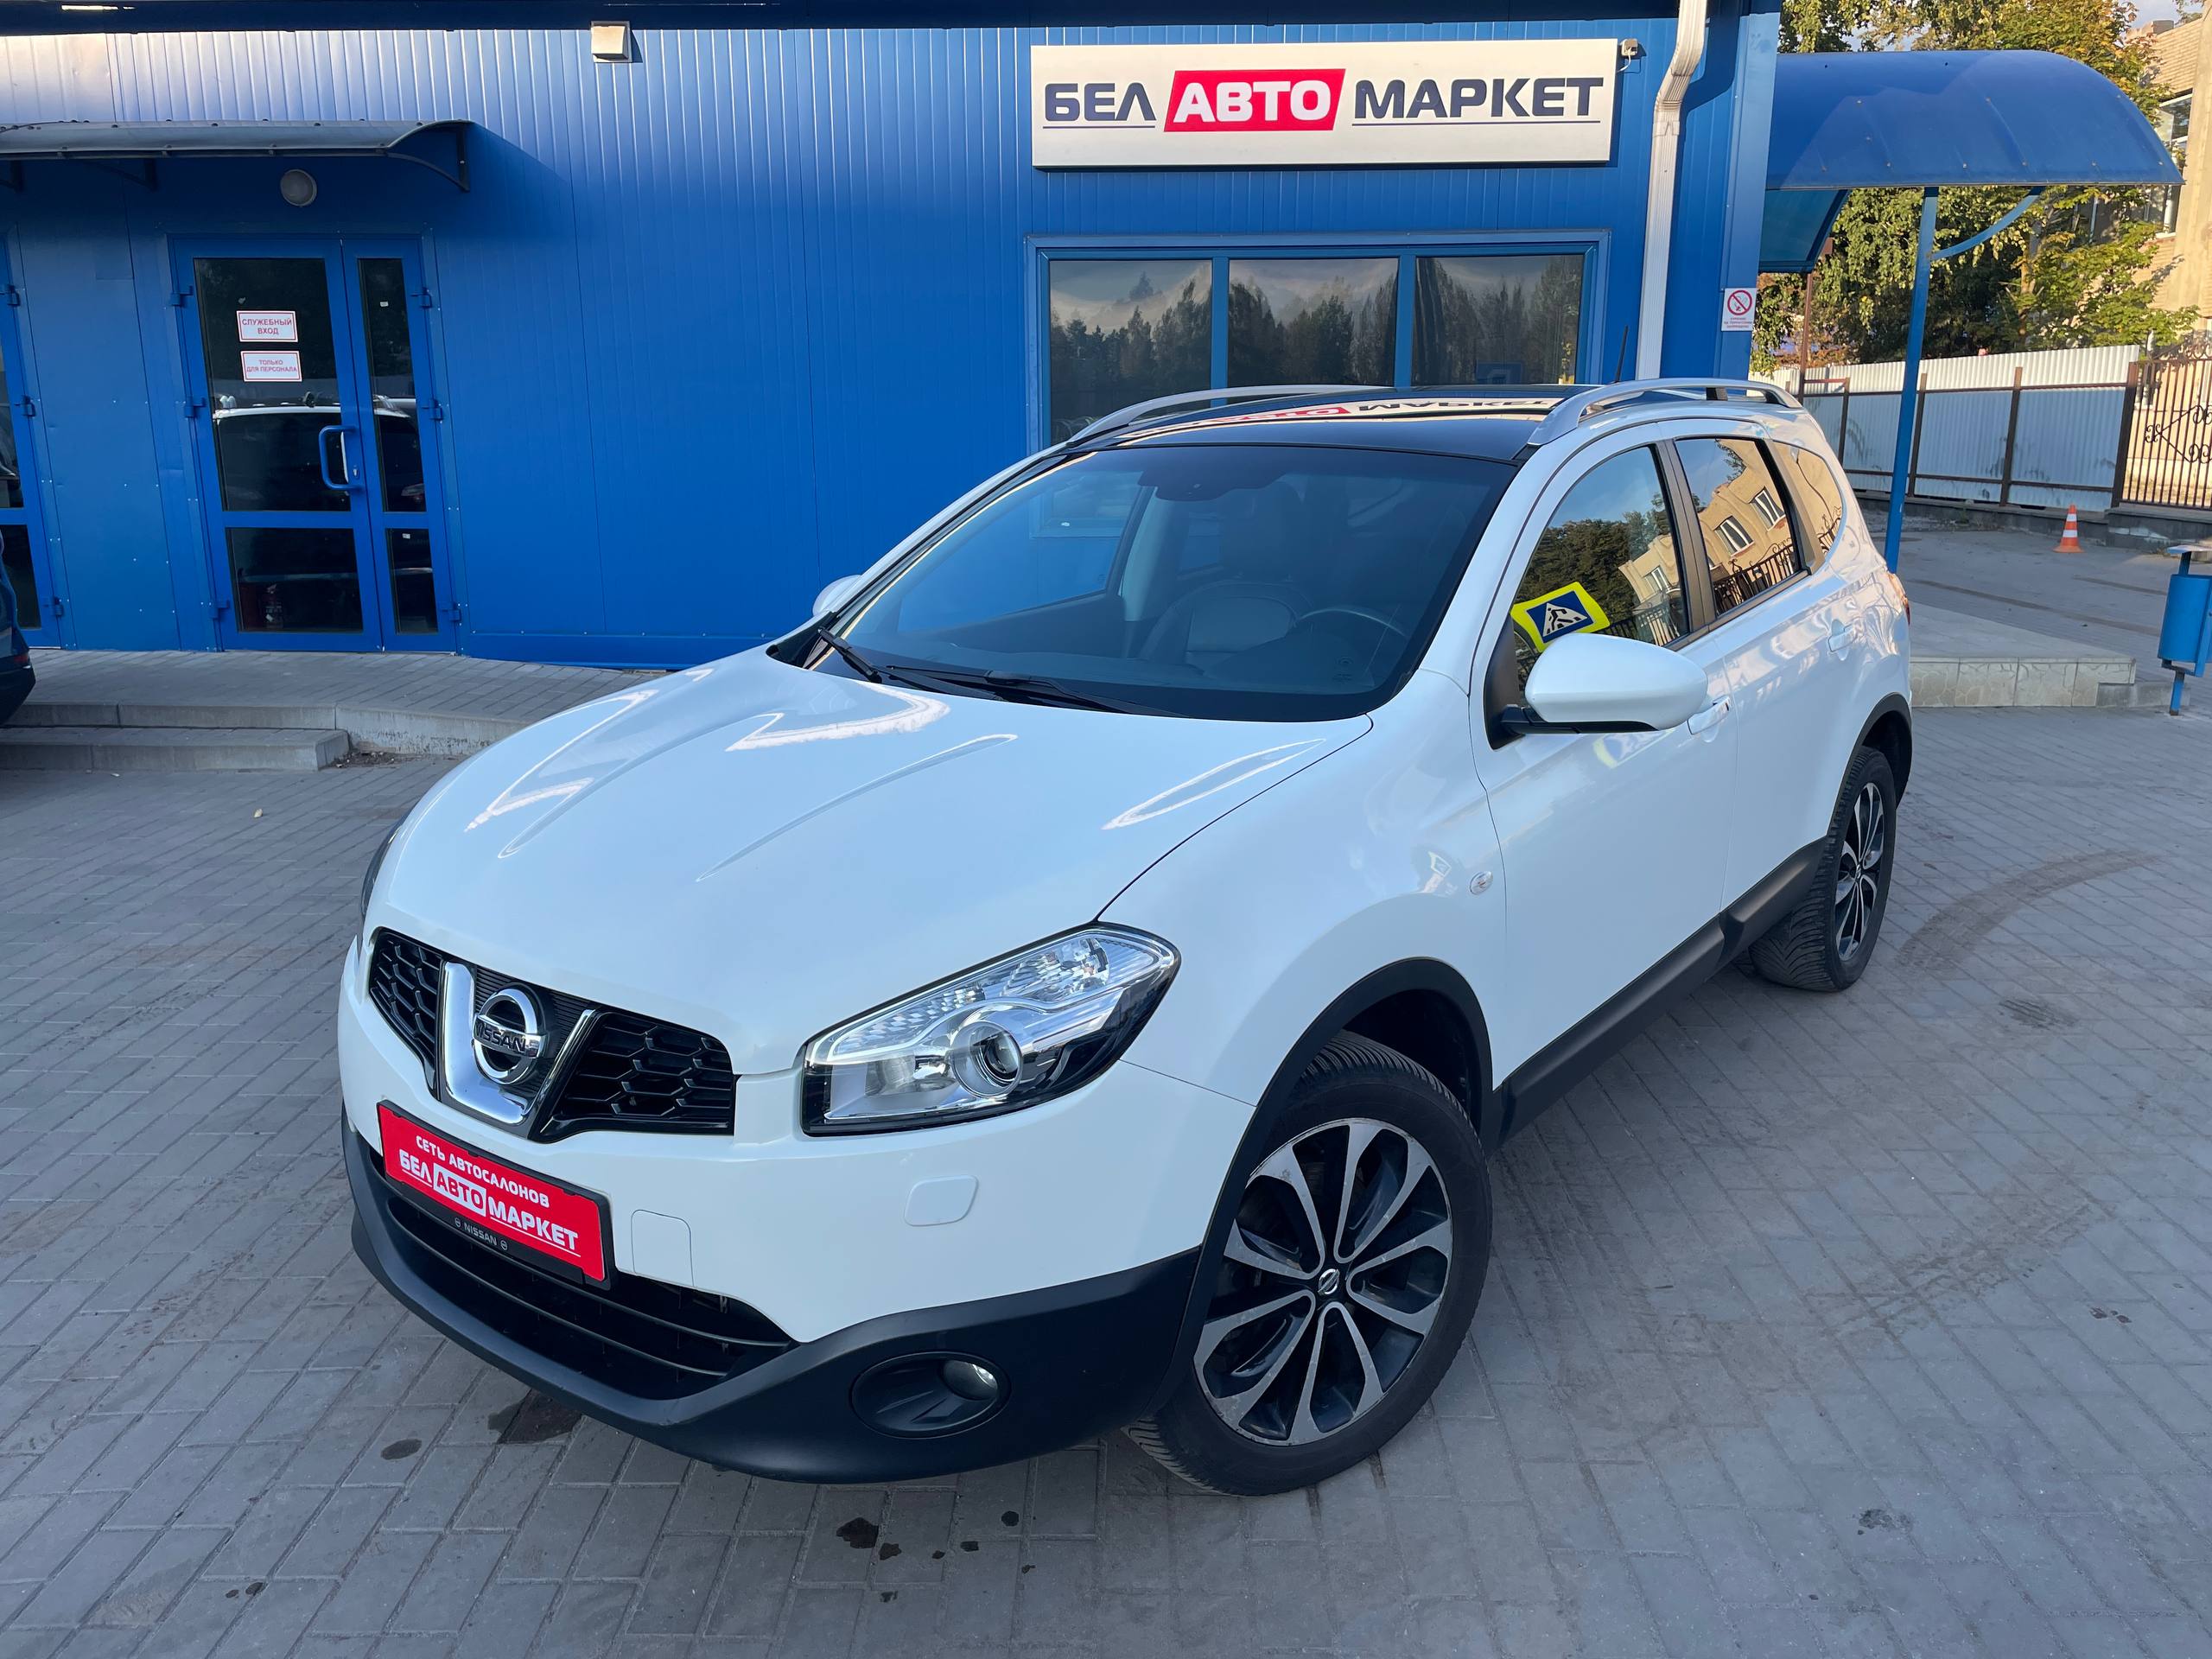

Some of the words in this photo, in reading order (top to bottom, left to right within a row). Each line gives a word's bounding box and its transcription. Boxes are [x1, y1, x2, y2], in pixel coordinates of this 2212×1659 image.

[1044, 82, 1156, 122] БЕЛ
[1173, 80, 1332, 123] АВТО
[1353, 77, 1604, 119] МАРКЕТ
[399, 1148, 433, 1183] БЕЛ
[435, 1170, 485, 1210] АВТО
[488, 1196, 578, 1250] МАРКЕТ
[416, 1135, 446, 1161] СЕТЬ
[448, 1154, 550, 1208] АВТОСАЛОНОВ
[464, 1222, 498, 1246] NISSAN
